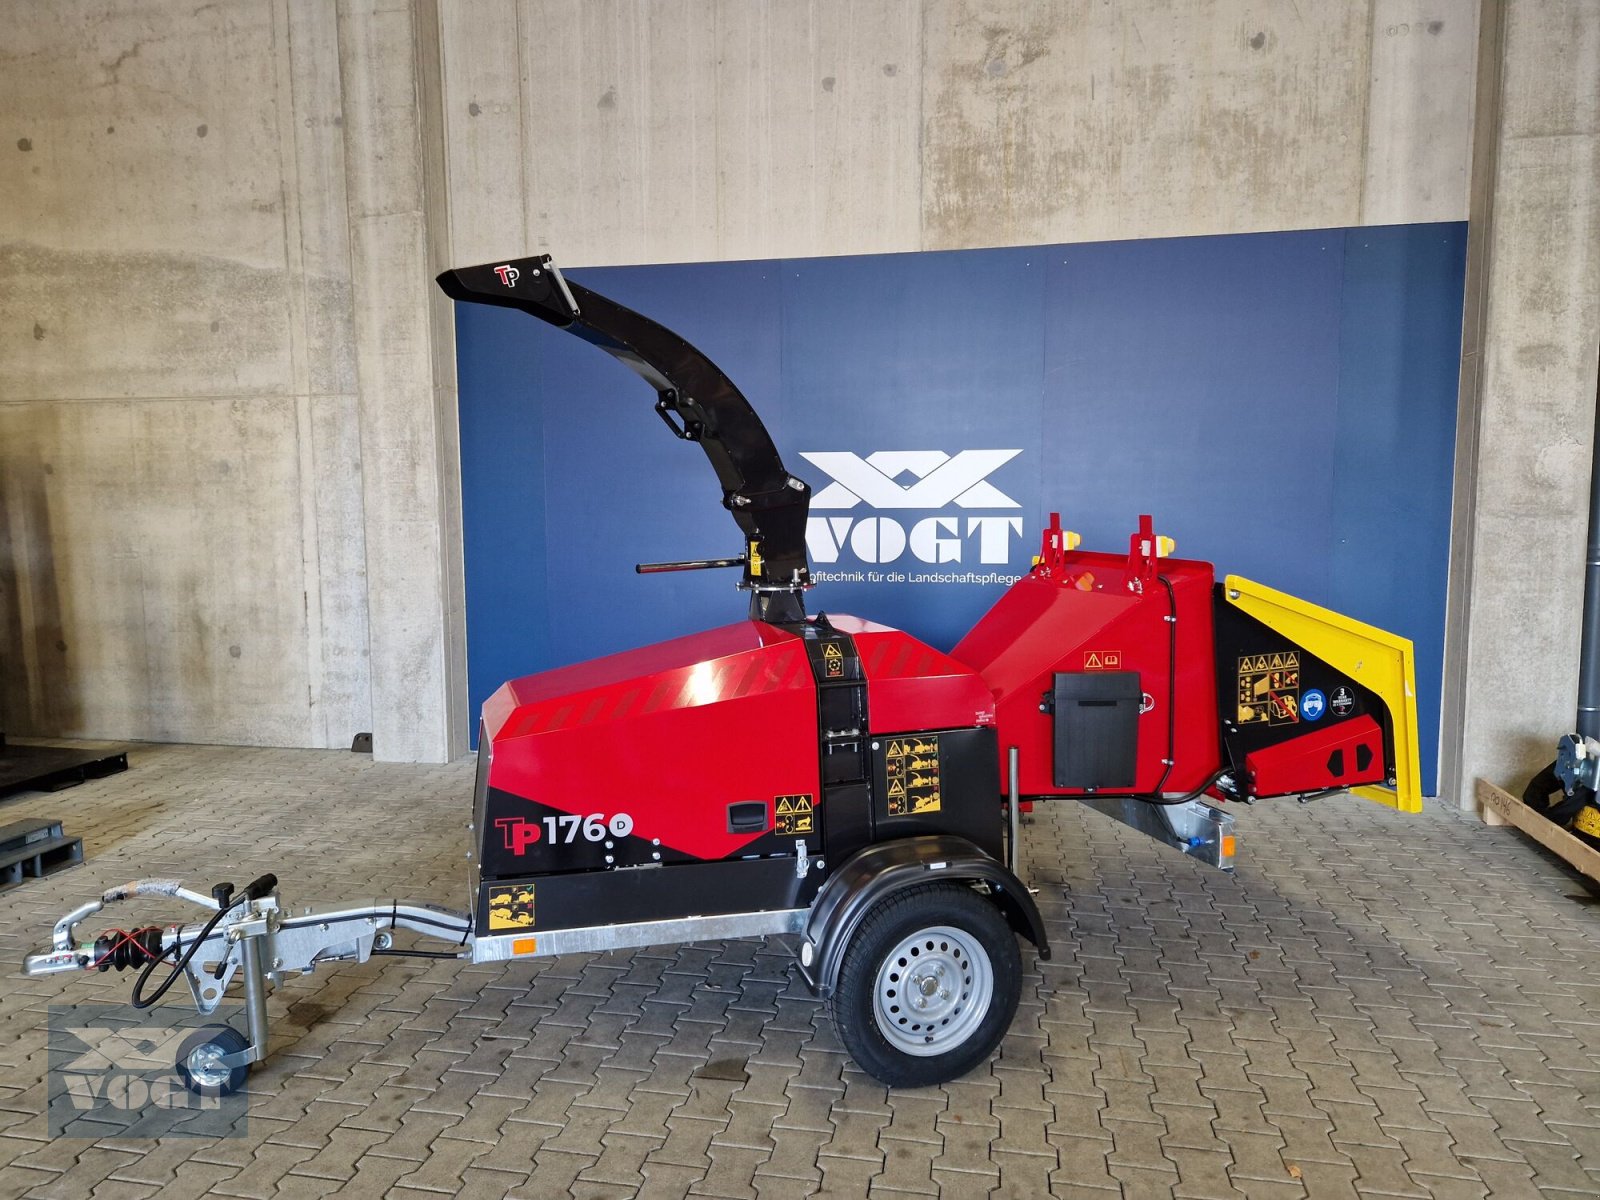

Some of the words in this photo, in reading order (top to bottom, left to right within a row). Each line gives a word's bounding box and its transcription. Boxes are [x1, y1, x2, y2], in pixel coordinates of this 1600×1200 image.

[494, 264, 520, 288] TP
[805, 517, 1023, 563] VOGT
[809, 571, 865, 583] ofitechnik
[867, 571, 885, 583] für
[886, 571, 906, 583] die
[908, 572, 1022, 587] Landschaftspflege
[495, 817, 541, 856] TP
[542, 812, 607, 845] 176
